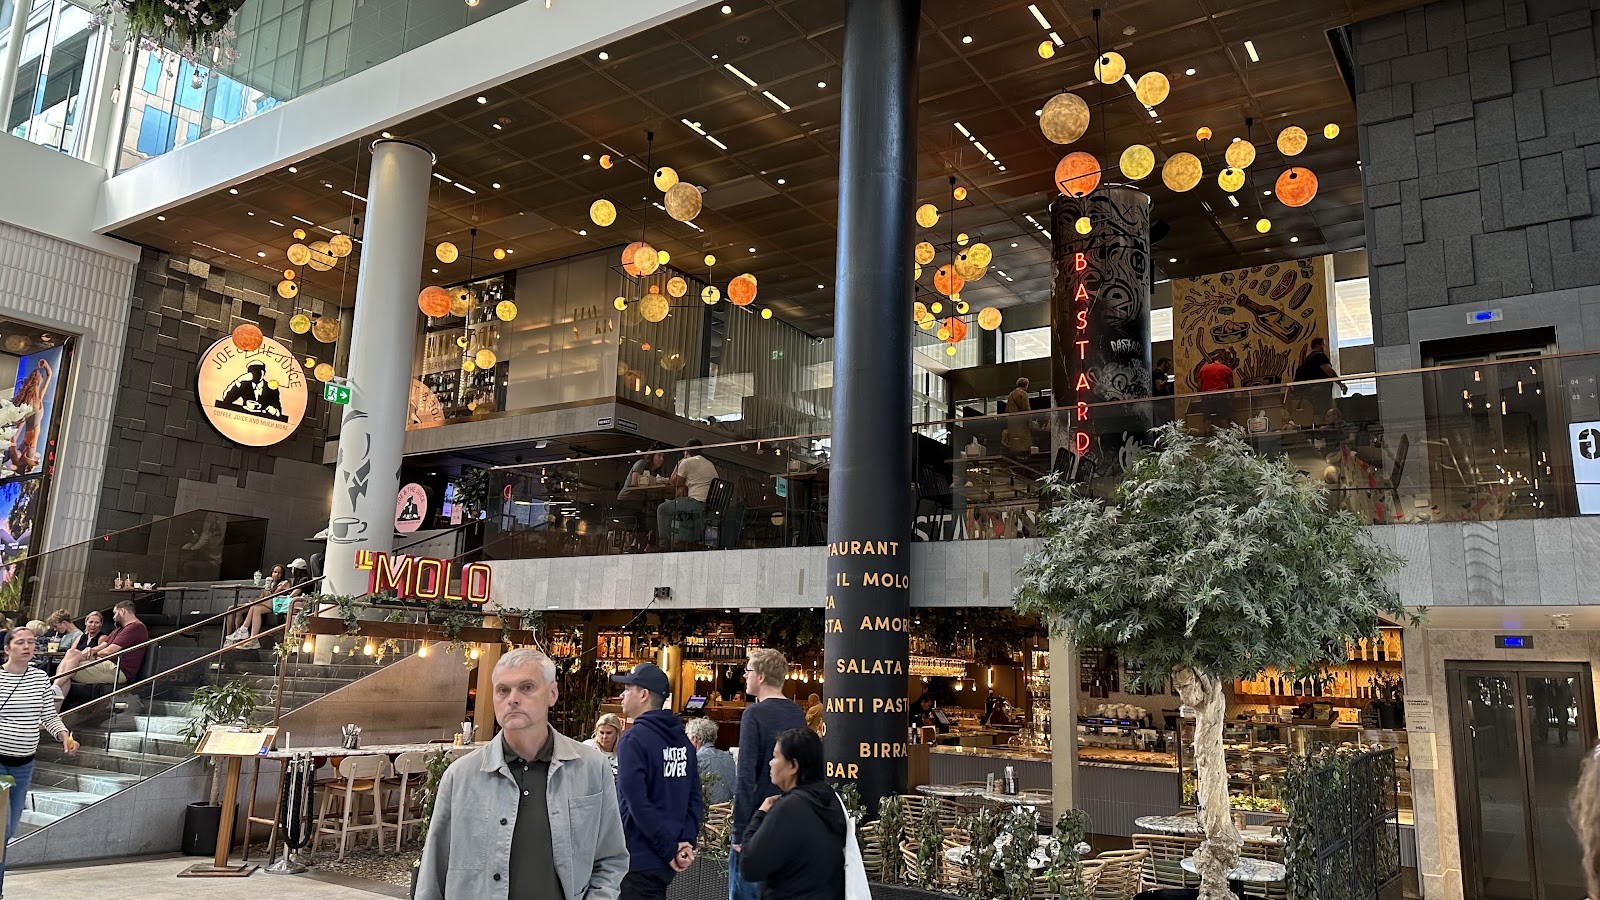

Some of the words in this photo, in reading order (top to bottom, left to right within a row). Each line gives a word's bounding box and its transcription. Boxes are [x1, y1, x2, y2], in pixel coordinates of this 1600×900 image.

[1074, 252, 1090, 451] BASTARD
[212, 346, 235, 370] JOE
[275, 356, 302, 388] JUICE
[234, 414, 248, 422] JUICE
[260, 420, 275, 428] MUCH
[275, 423, 289, 431] MORE
[355, 549, 373, 570] IL
[368, 551, 491, 604] MOLO
[836, 572, 850, 587] IL
[863, 571, 909, 589] MOLO
[836, 658, 903, 675] SALATA
[826, 697, 864, 713] ANTI
[872, 697, 910, 713] PAST
[663, 746, 687, 761] WATER
[860, 742, 908, 758] BIRRA
[663, 759, 687, 777] LOVER
[826, 761, 859, 779] BAR
